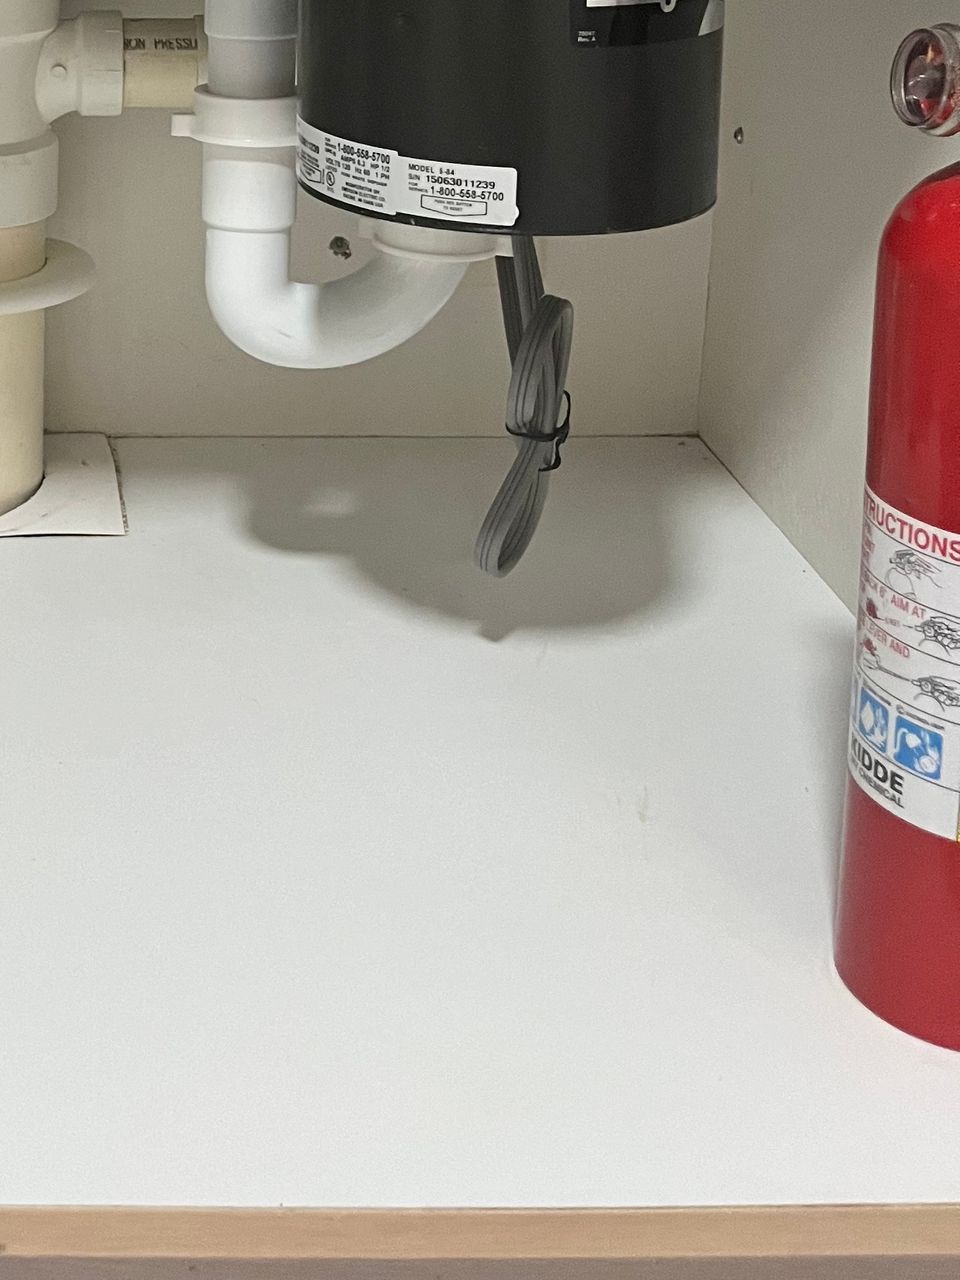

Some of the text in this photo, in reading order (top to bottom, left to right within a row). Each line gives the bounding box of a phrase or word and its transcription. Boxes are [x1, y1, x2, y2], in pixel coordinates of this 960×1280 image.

[338, 142, 390, 164] 1-800-558-5700
[408, 163, 434, 174] MODEL
[426, 175, 496, 190] 15063011239
[430, 186, 504, 201] 1-800-558-5700
[890, 594, 910, 613] AIM
[911, 605, 926, 619] AT
